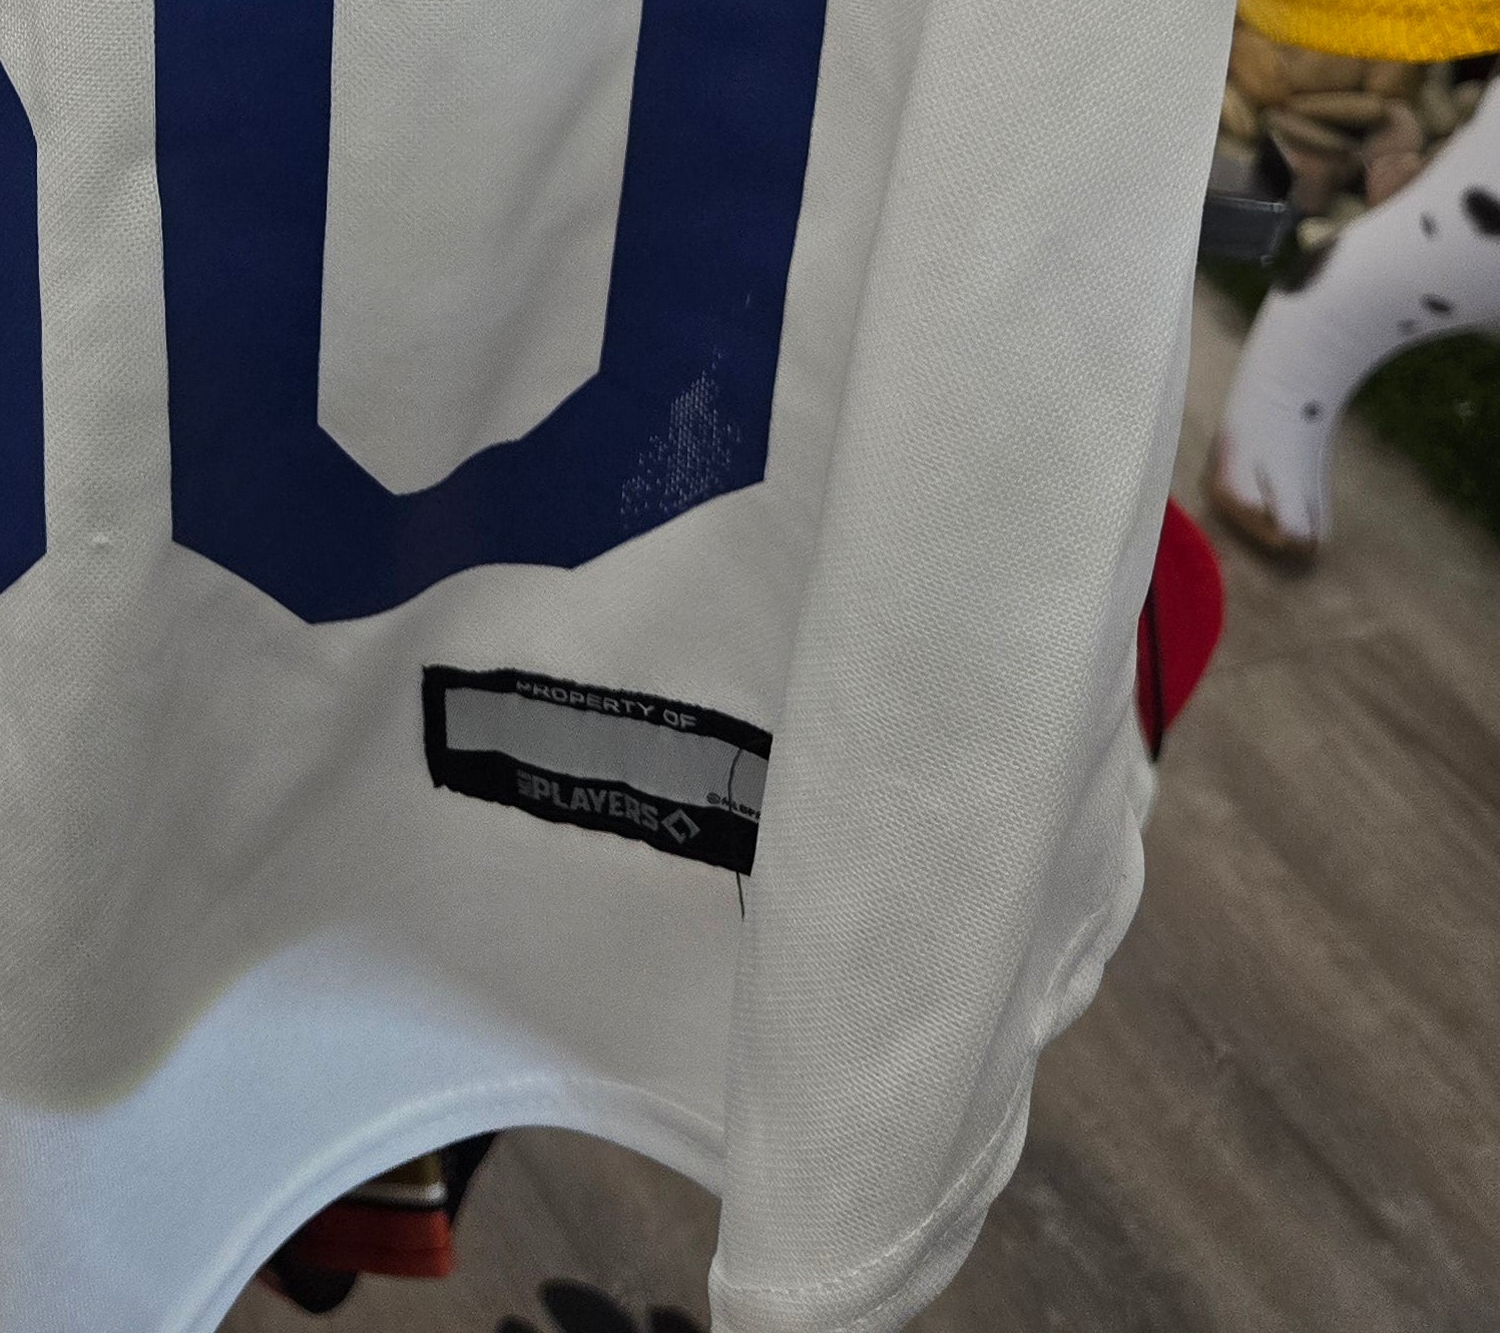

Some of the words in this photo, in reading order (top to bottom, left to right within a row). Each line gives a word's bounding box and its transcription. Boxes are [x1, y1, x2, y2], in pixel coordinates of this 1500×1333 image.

[516, 680, 654, 717] PROPERTY
[662, 708, 697, 729] OF
[532, 773, 659, 832] PLAYERS
